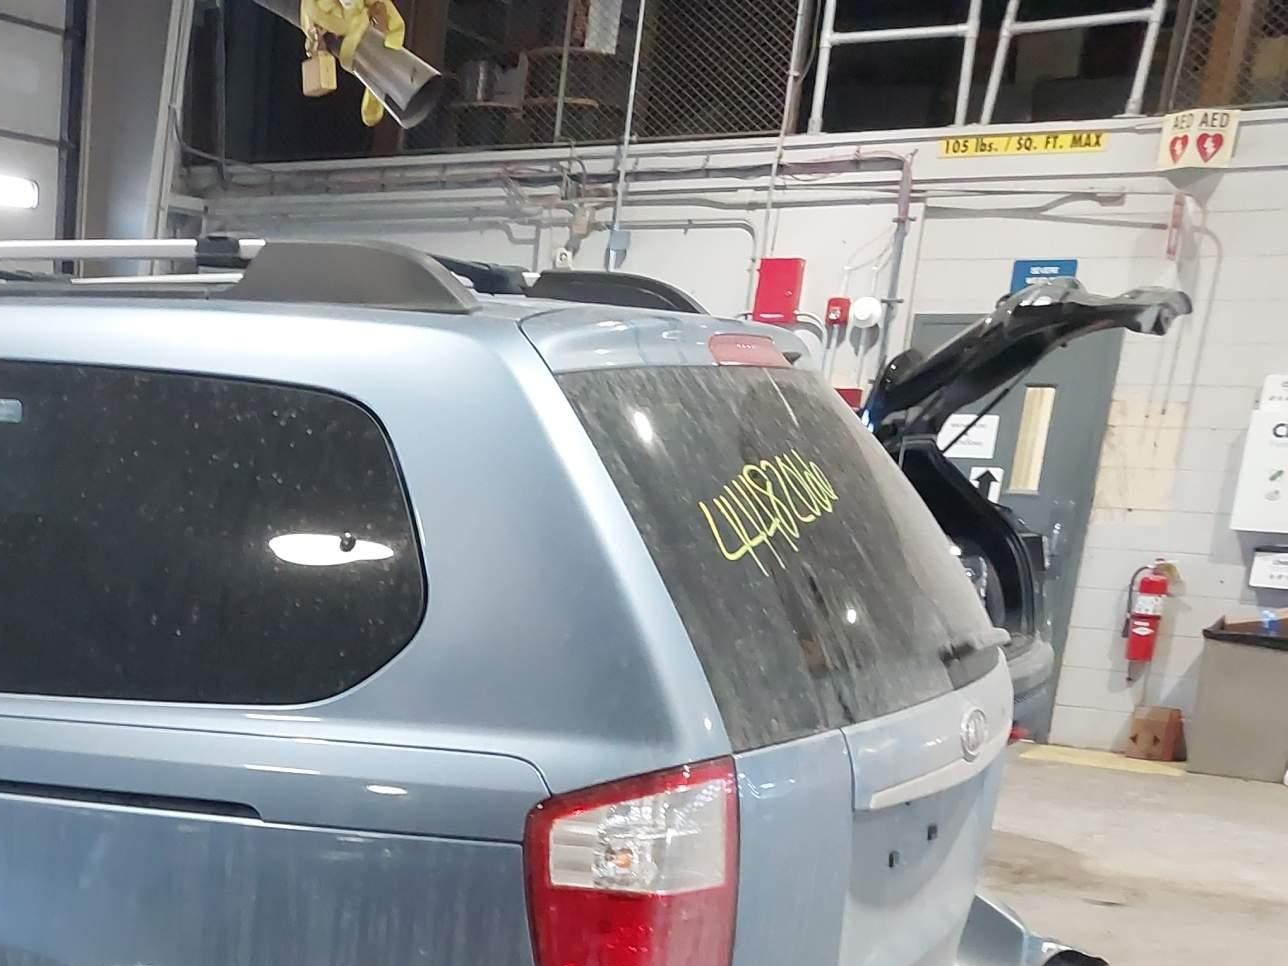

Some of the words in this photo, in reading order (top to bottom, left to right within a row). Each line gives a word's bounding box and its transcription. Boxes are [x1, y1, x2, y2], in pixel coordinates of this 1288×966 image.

[1198, 111, 1230, 128] AED
[945, 140, 969, 154] 105
[975, 138, 998, 152] lbs.
[1016, 137, 1037, 151] SQ.
[1045, 135, 1063, 149] FT.
[1070, 133, 1103, 148] MAX
